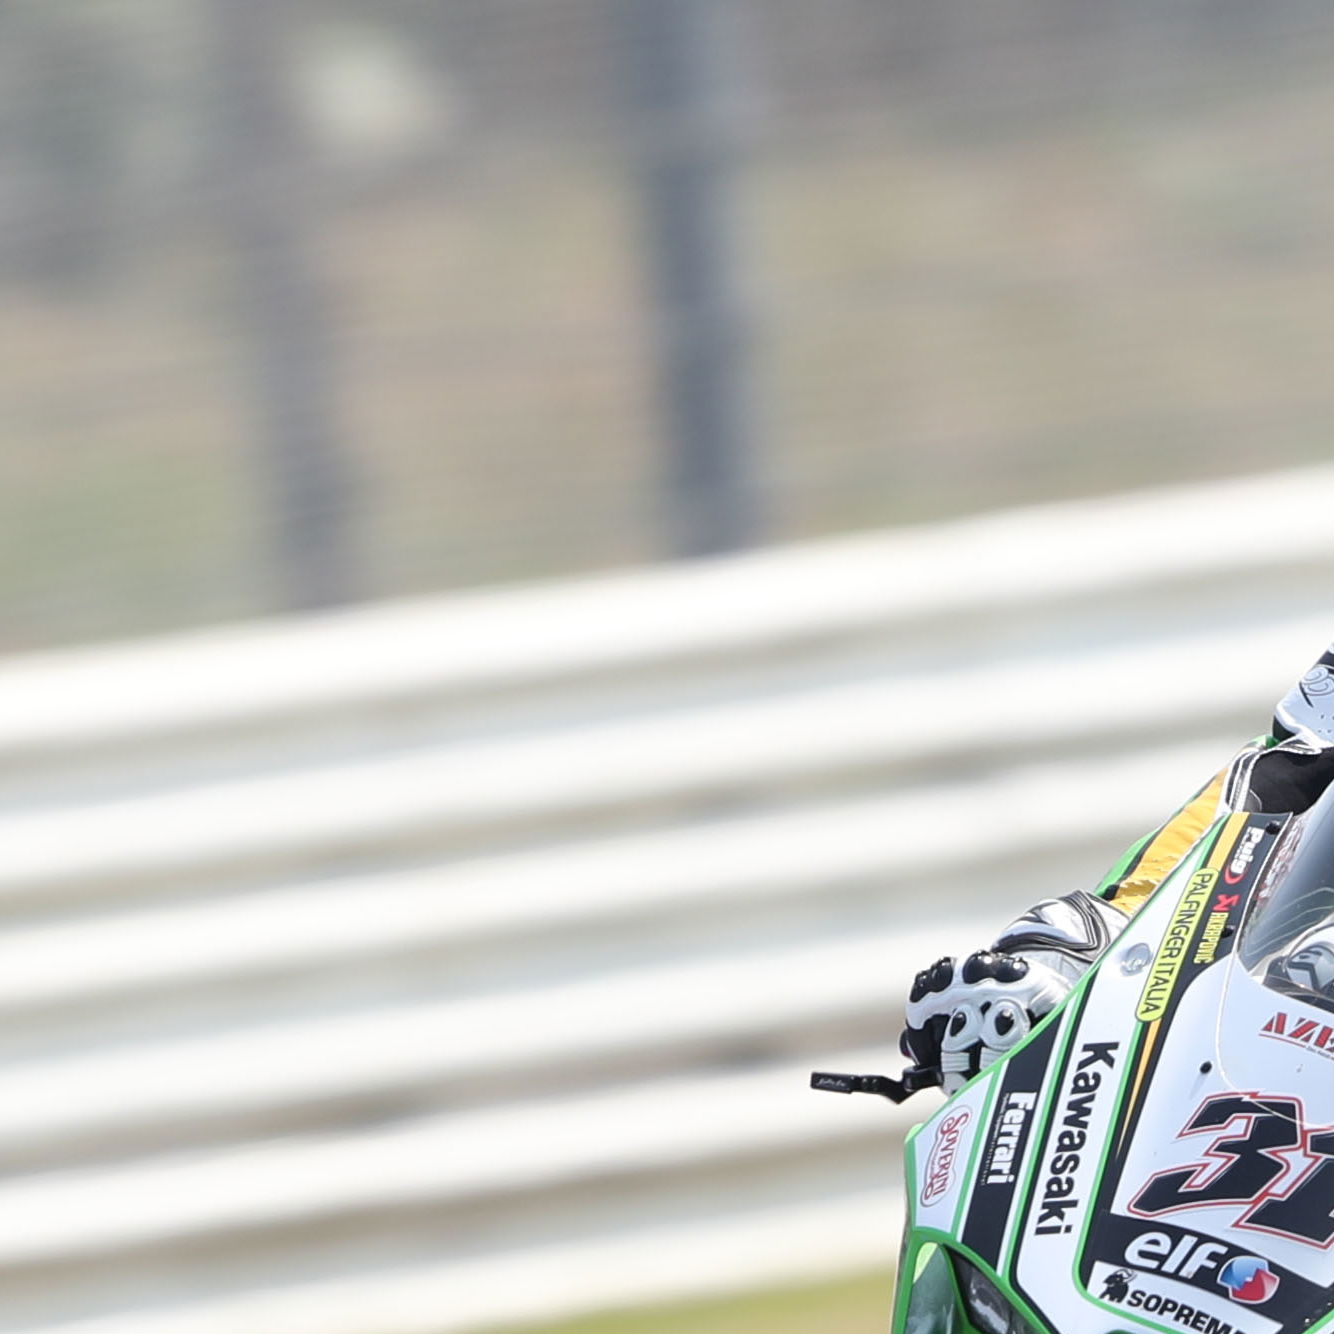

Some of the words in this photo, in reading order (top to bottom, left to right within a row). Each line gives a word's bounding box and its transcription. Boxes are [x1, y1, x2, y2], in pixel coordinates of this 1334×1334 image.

[1231, 826, 1265, 874] Puig
[1161, 873, 1213, 960] PALFINGER
[1141, 962, 1177, 1014] ITALIA
[987, 1092, 1037, 1184] Ferrari
[1035, 1041, 1119, 1236] Kawasaki
[1124, 1232, 1228, 1279] elf
